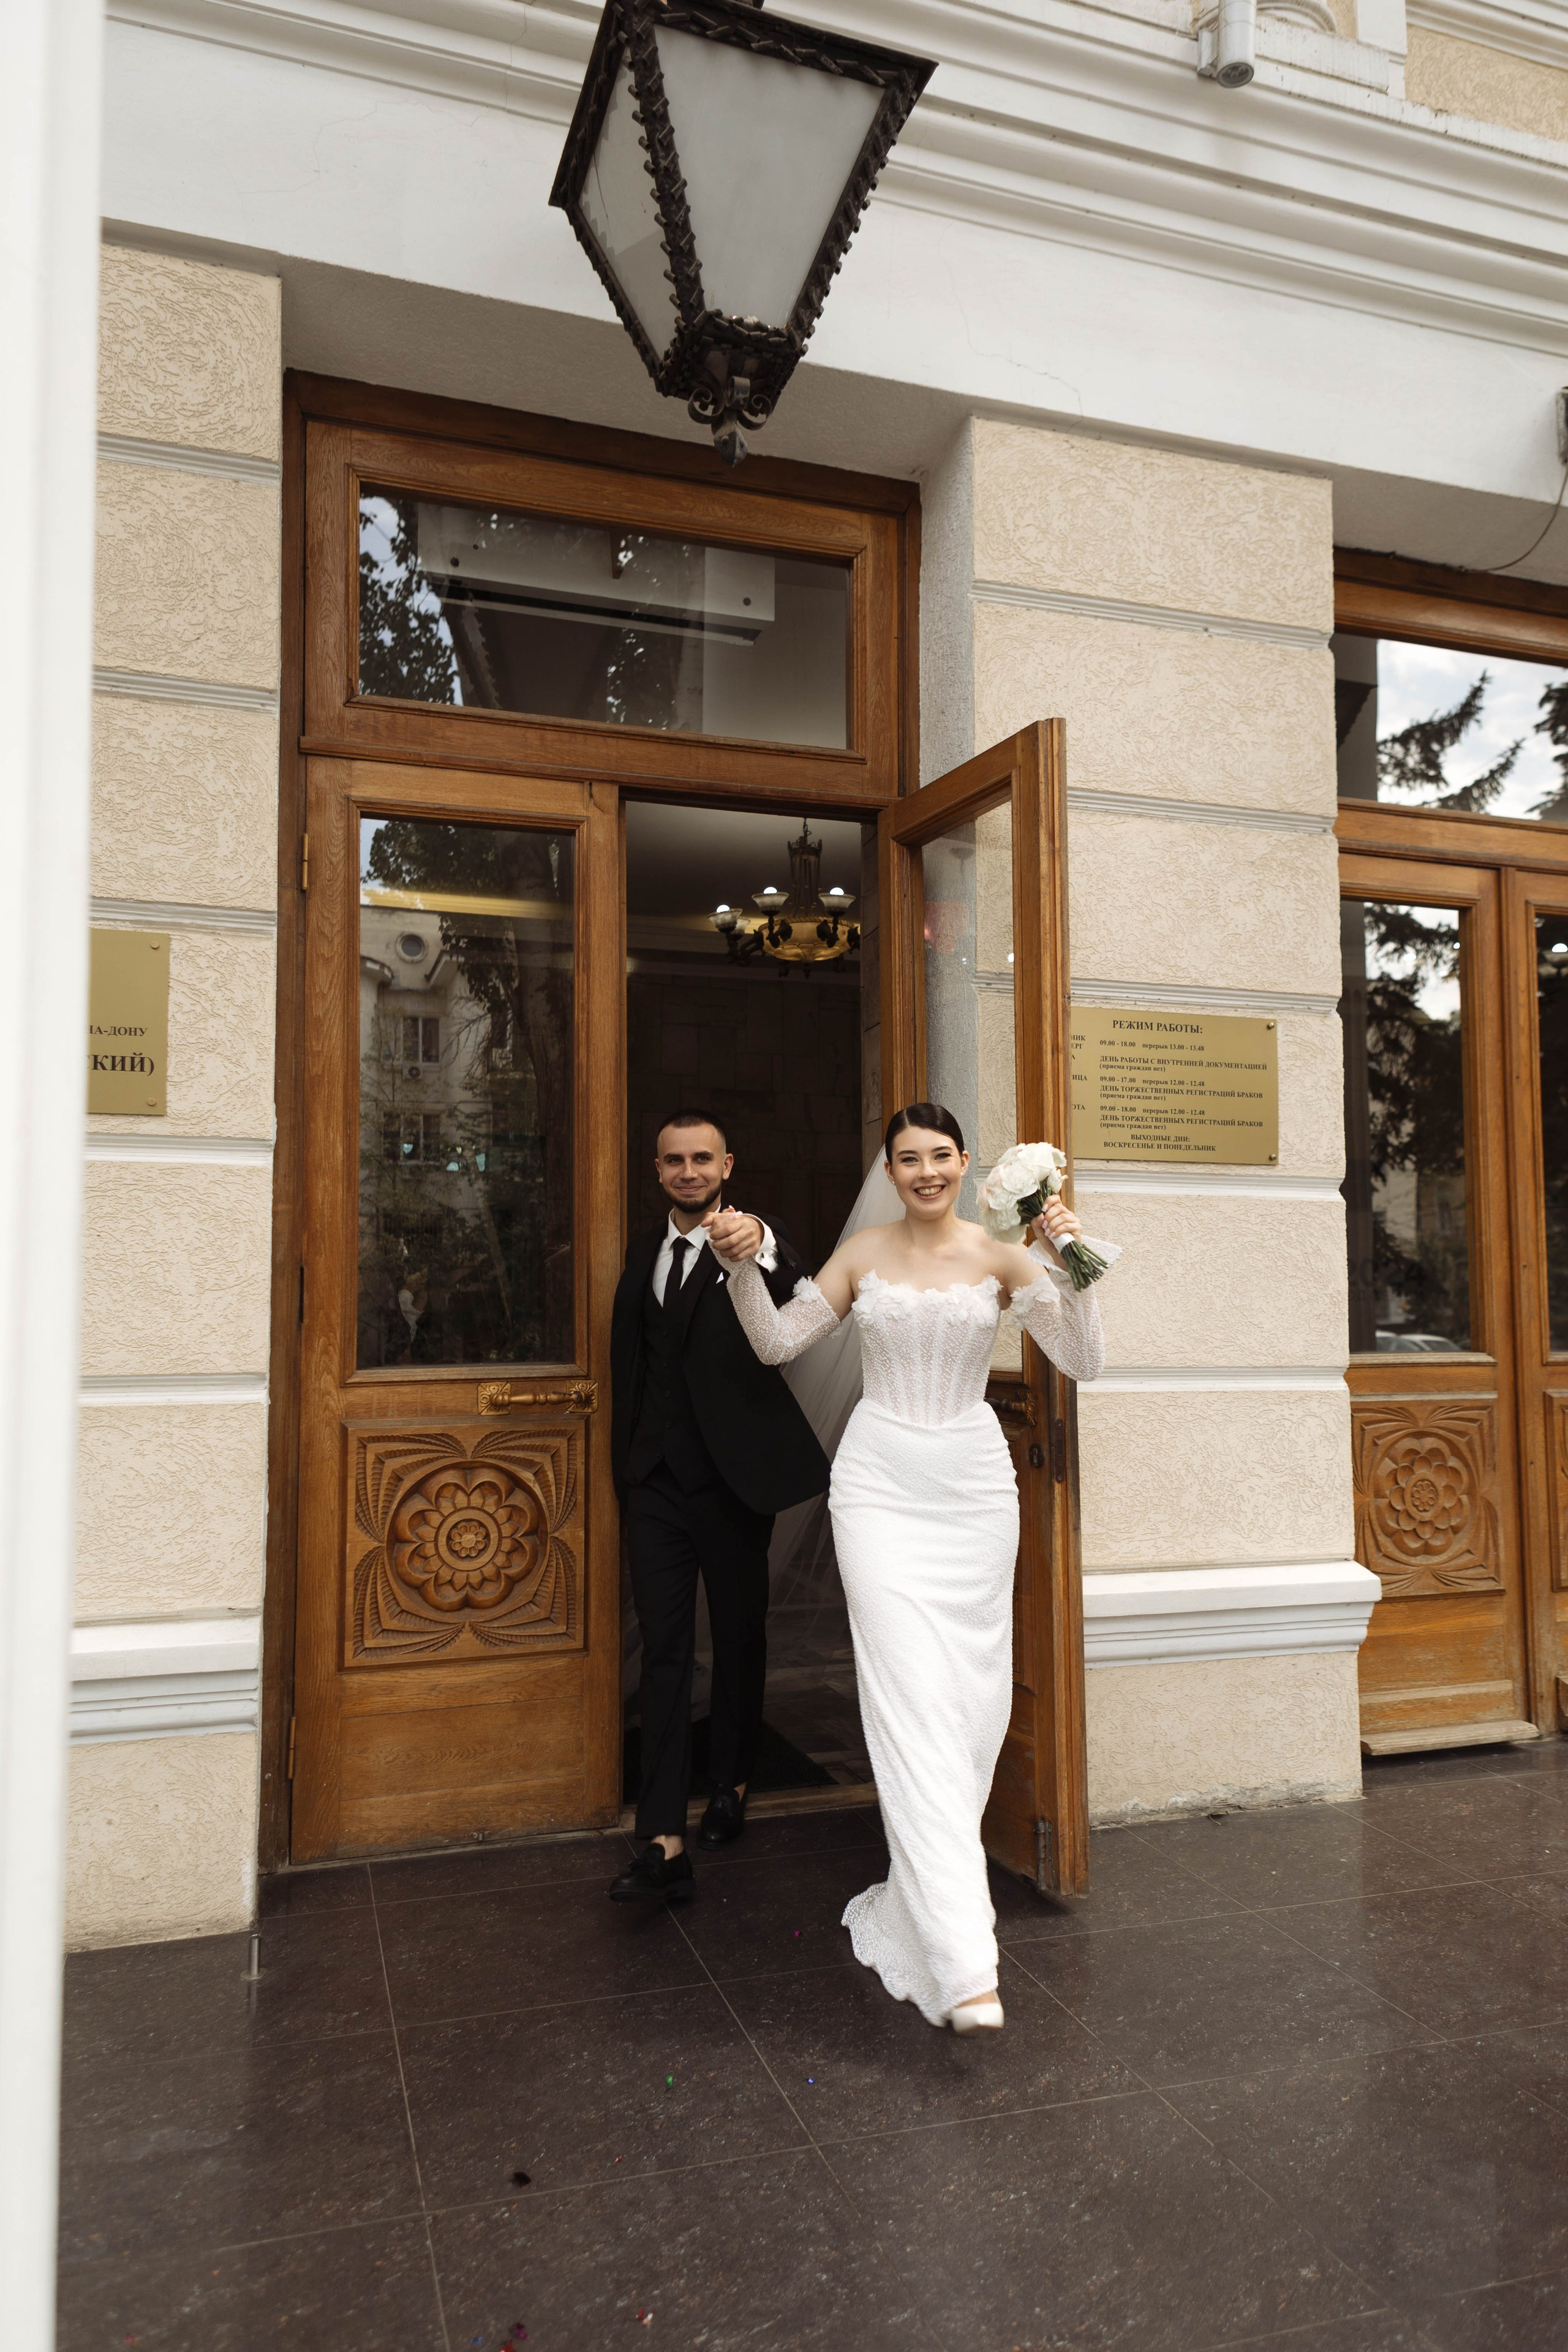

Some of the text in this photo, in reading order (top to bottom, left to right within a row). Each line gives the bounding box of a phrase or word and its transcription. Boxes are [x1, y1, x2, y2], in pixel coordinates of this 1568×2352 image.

[1112, 1020, 1203, 1034] РЕЖИМ РАБОТЫ:
[86, 1052, 155, 1077] КИЙ)
[1205, 1061, 1267, 1070] ДОКУМЕНТАЦИЕЙ
[1121, 1086, 1185, 1095] ТОРЖЕСТВЕННЫХ
[1121, 1115, 1185, 1124] ТОРЖЕСТВЕННЫХ
